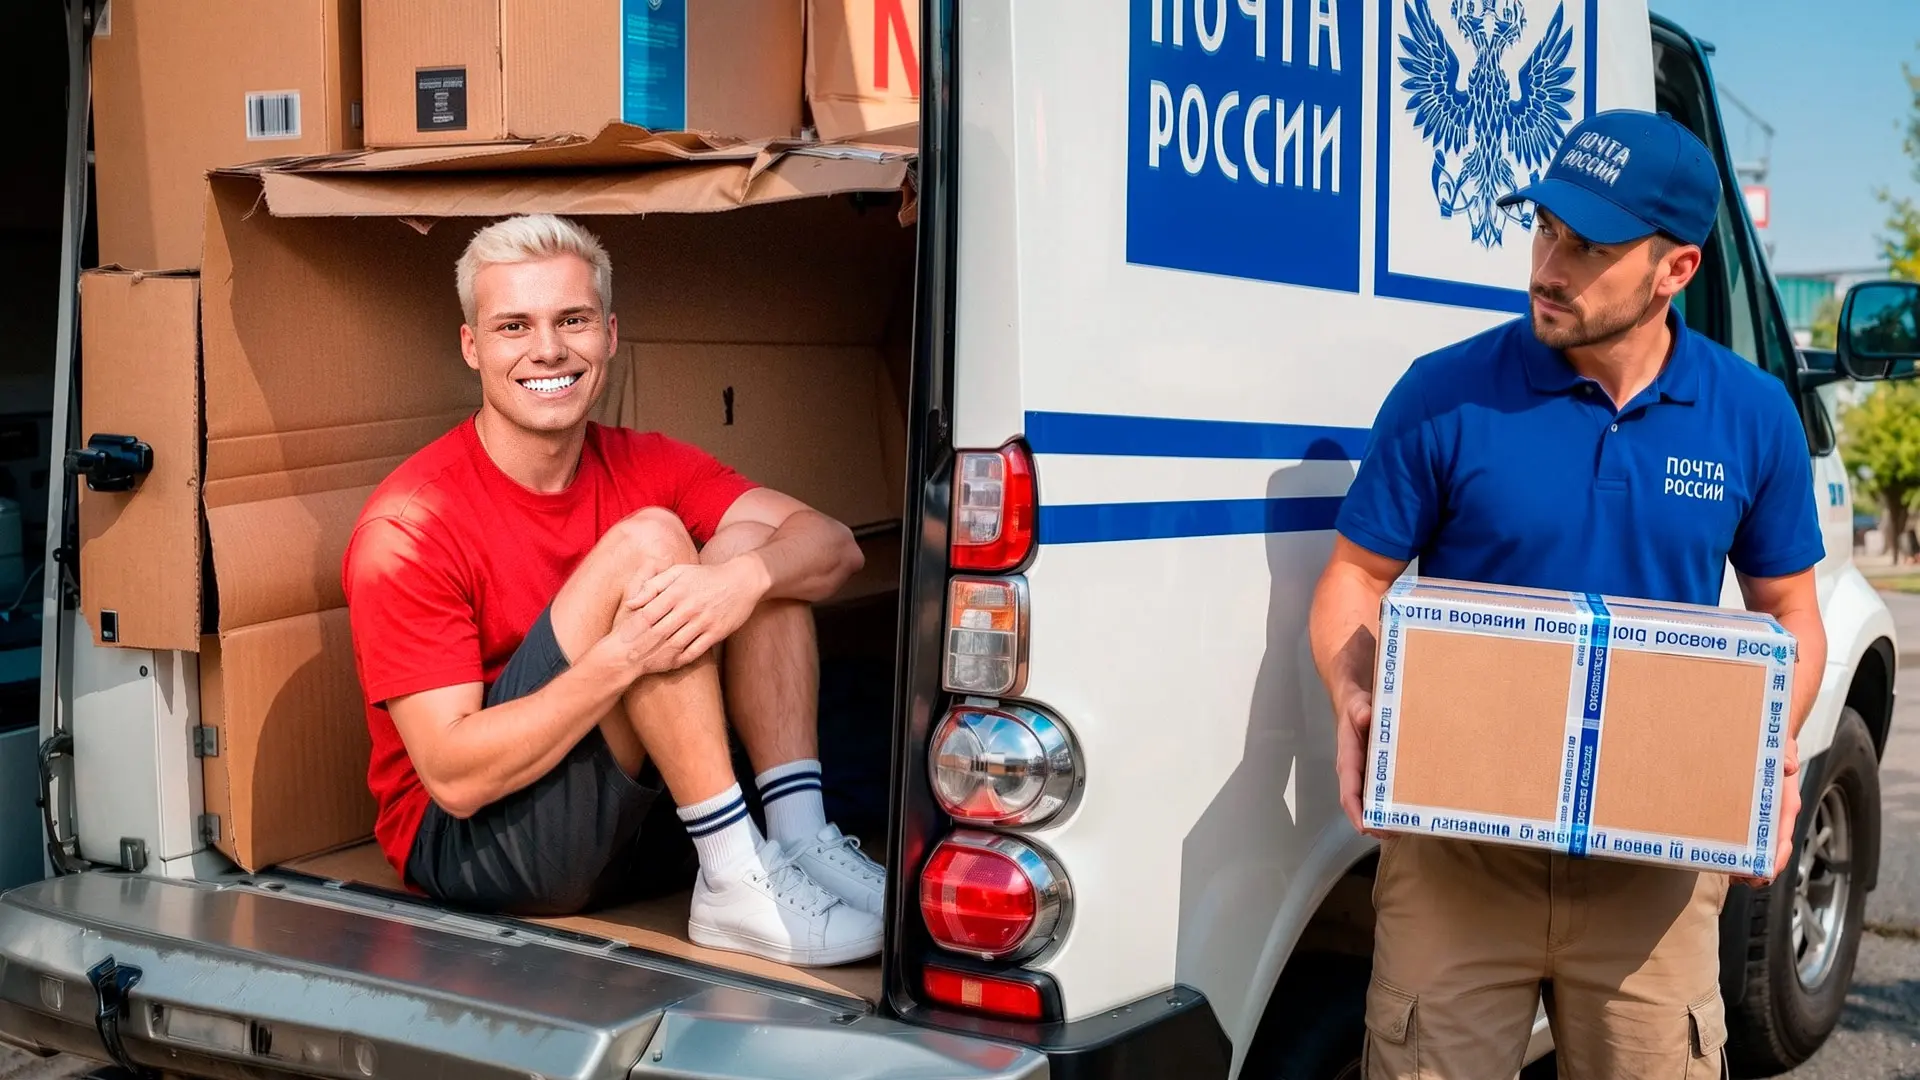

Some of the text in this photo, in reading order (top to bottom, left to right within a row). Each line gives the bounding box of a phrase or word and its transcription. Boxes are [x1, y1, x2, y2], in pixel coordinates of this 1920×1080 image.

[1149, 79, 1342, 194] РОССИИ
[1575, 131, 1631, 166] ПОЧТА
[1560, 149, 1621, 187] РОССИИ
[1666, 456, 1725, 482] ПОЧТА
[1664, 477, 1724, 502] РОССИИ
